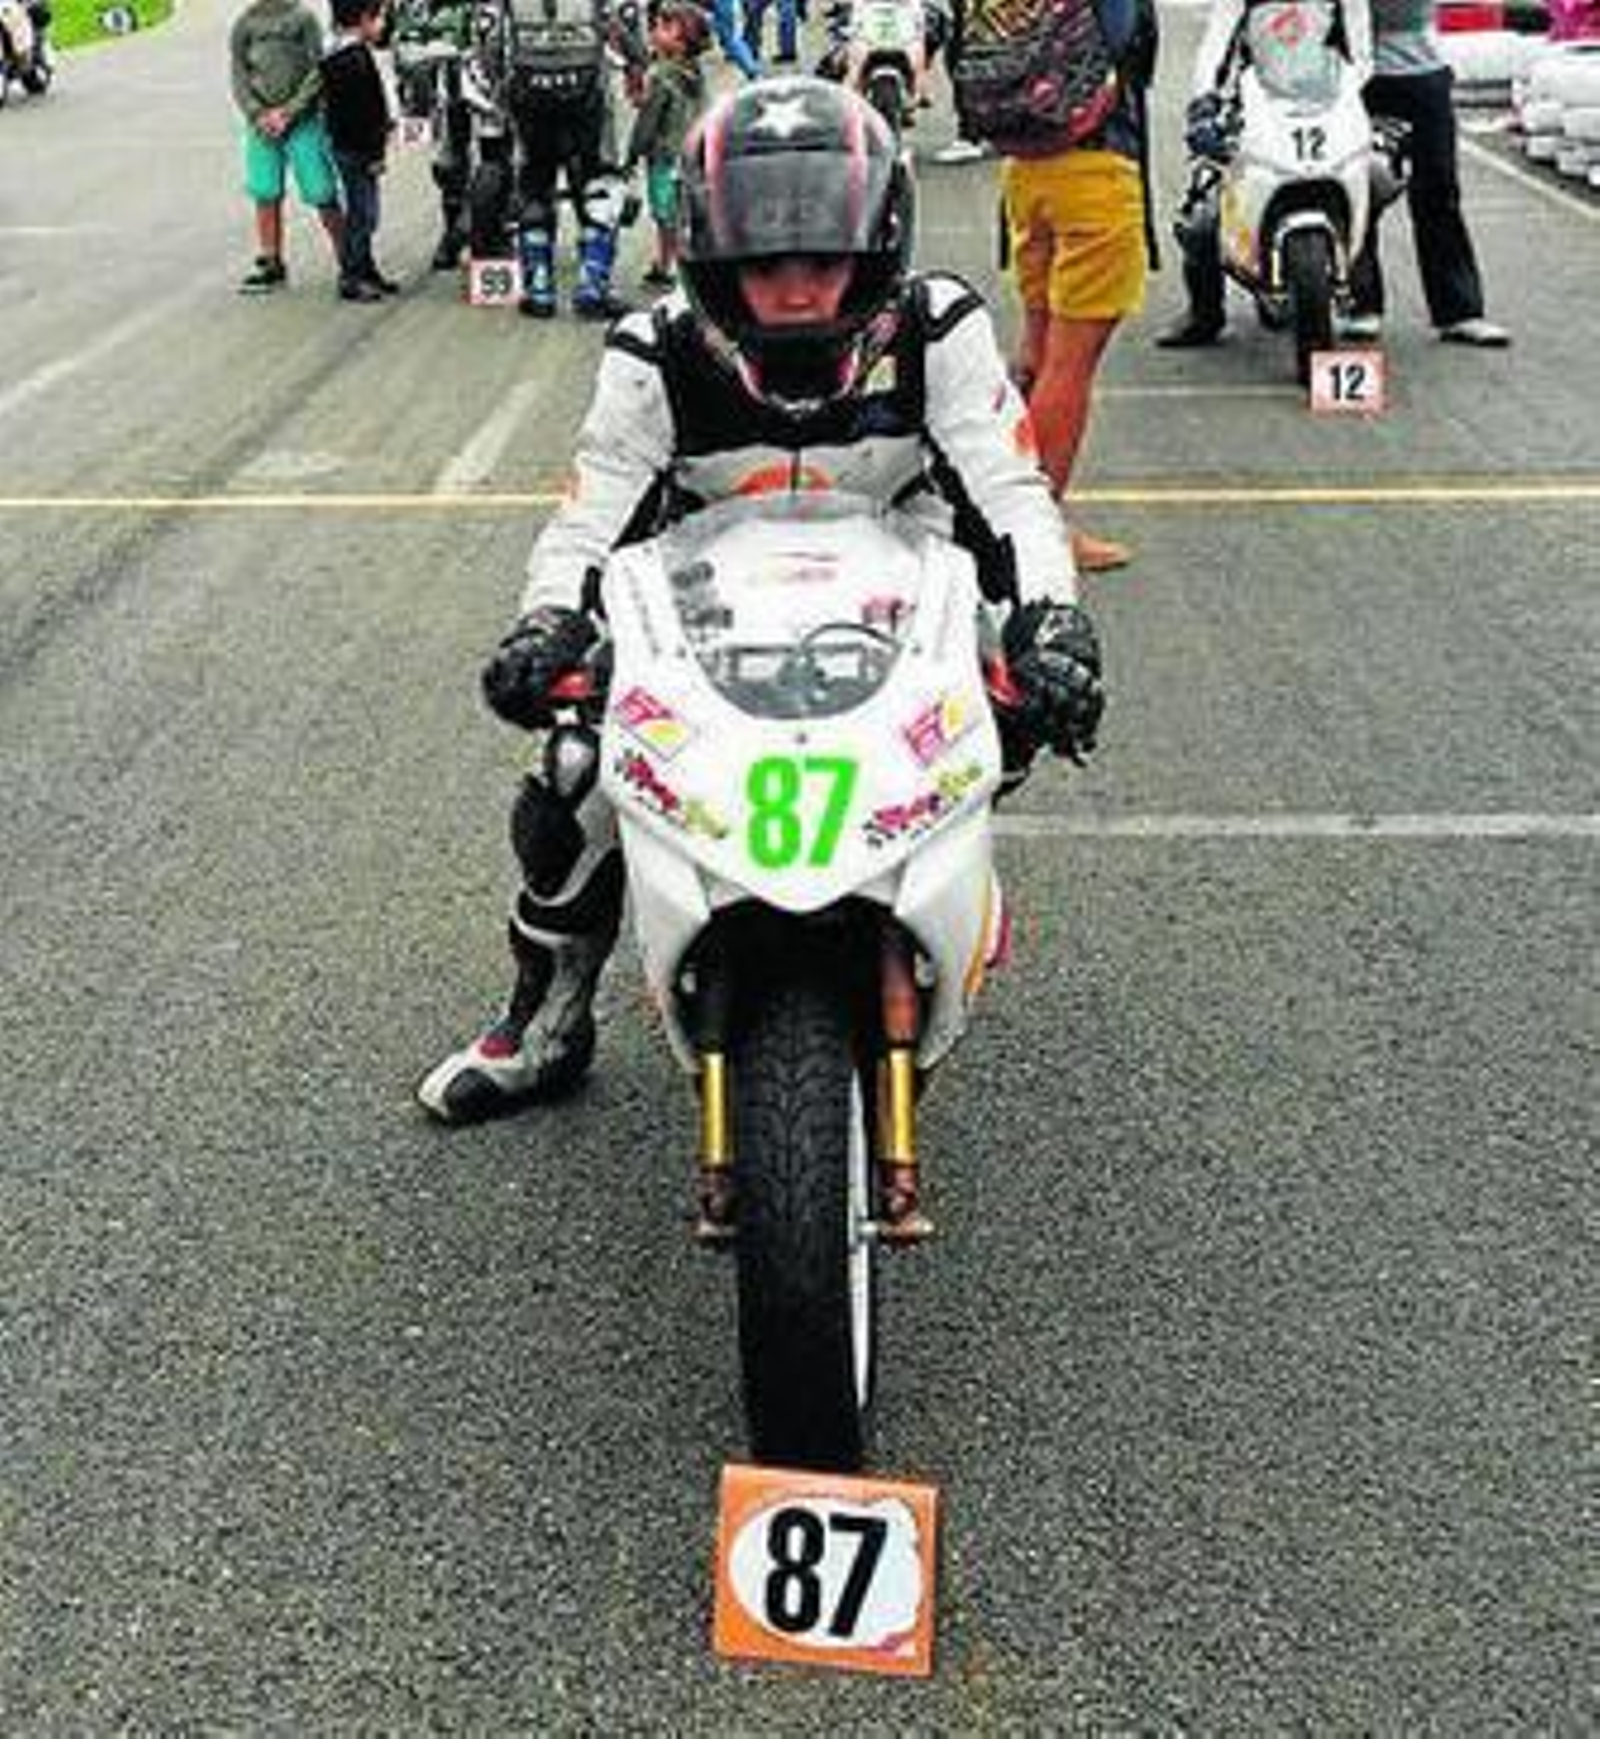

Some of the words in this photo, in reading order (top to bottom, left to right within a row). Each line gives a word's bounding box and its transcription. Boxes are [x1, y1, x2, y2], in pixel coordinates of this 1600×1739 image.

[1290, 126, 1327, 162] 12
[1328, 363, 1366, 402] 12
[747, 757, 859, 869] 87
[766, 1507, 888, 1638] 87
